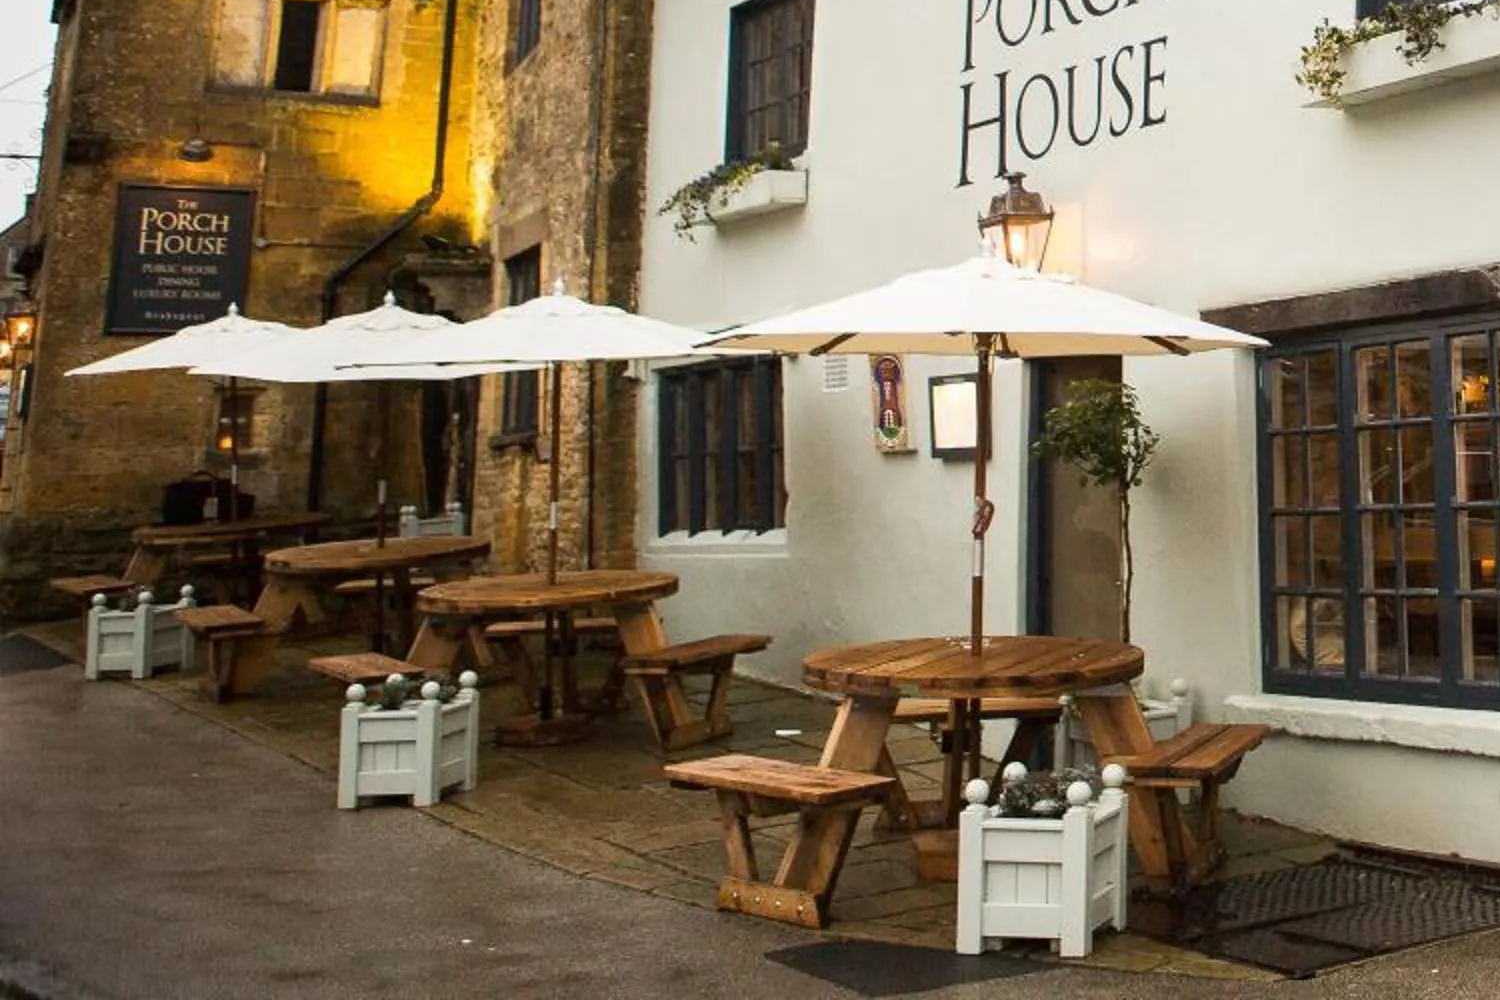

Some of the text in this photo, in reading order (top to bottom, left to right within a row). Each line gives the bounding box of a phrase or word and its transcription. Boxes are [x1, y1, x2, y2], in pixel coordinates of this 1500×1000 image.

[954, 35, 1169, 188] HOUSE
[140, 207, 232, 233] PORCH
[138, 231, 229, 255] HOUSE
